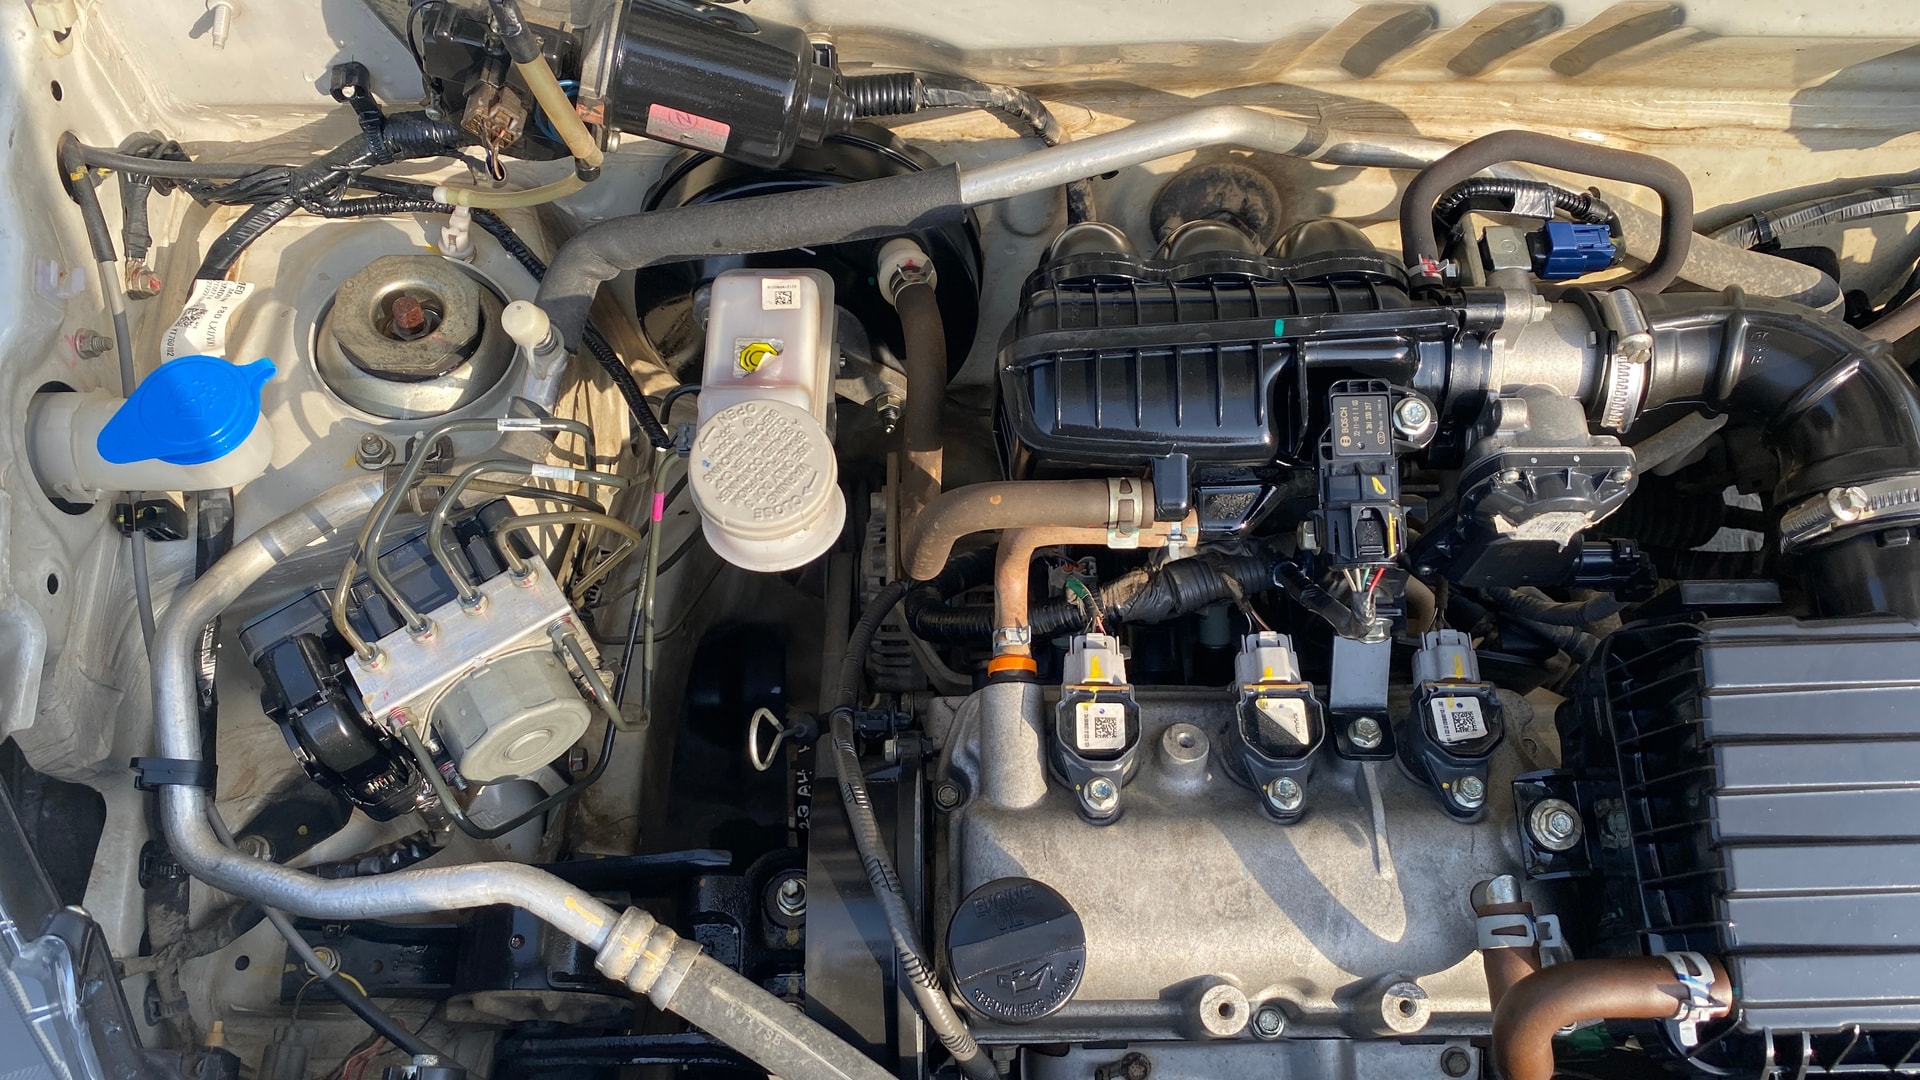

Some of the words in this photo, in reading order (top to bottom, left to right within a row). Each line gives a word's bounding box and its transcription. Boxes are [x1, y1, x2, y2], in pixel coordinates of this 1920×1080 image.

[717, 403, 757, 425] OPEN
[744, 407, 781, 444] BEFORE
[1339, 406, 1350, 433] BOSCH
[758, 415, 789, 447] CLEAN
[760, 425, 796, 461] SEALED
[776, 430, 808, 462] BRAKE
[702, 439, 748, 485] REMOVING
[708, 432, 739, 462] BOSCH
[730, 442, 761, 474] FILLER
[791, 440, 814, 463] USE
[713, 469, 735, 492] CAP
[715, 456, 764, 504] CONTAINER
[754, 456, 781, 483] FLUID
[767, 461, 812, 505] WARNING
[770, 458, 796, 484] ONLY
[730, 479, 758, 507] FROM
[752, 480, 774, 502] DOT
[753, 495, 802, 519] CLOSE
[972, 884, 1035, 918] ENGINE
[998, 910, 1025, 931] OIL
[1046, 959, 1079, 1005] MANUAL
